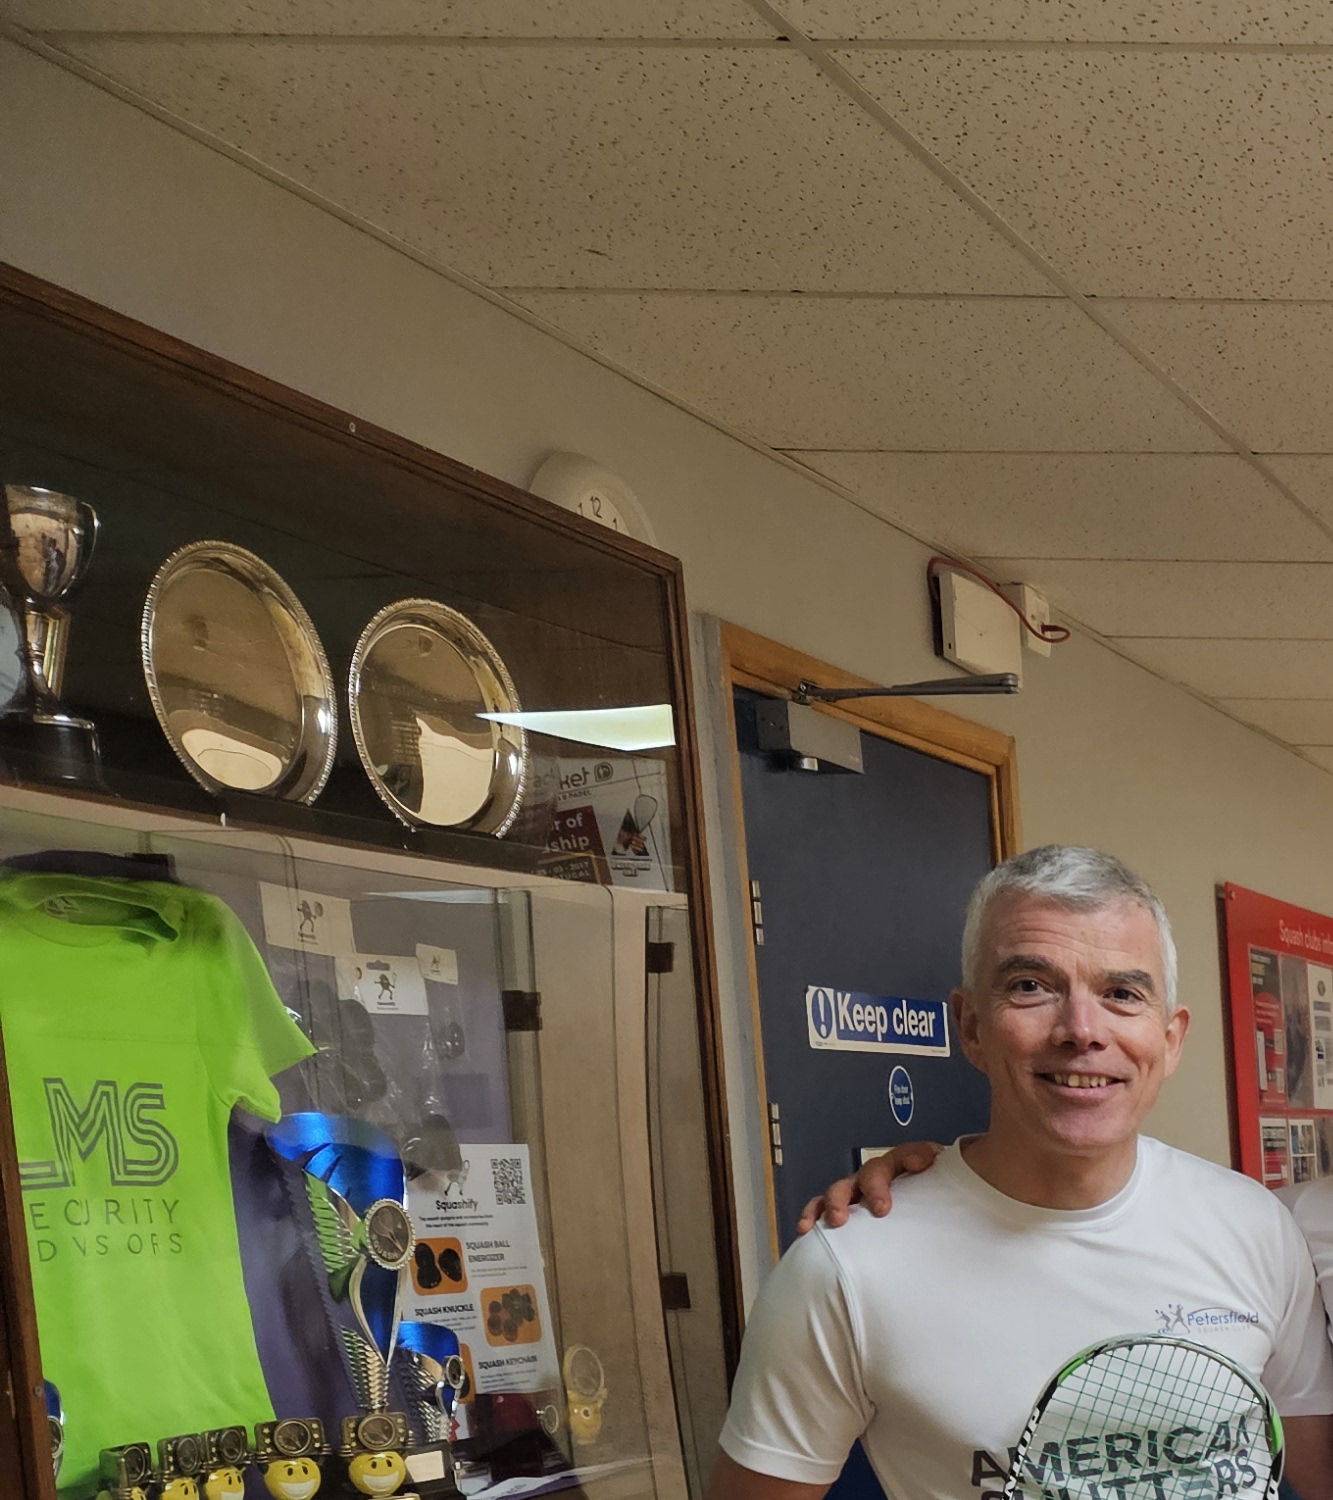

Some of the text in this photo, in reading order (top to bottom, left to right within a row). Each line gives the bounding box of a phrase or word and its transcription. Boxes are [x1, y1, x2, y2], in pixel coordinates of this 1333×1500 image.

[589, 496, 602, 519] 12
[1279, 919, 1303, 948] Squash
[1304, 926, 1321, 951] clubs
[836, 992, 936, 1042] Keep clear
[29, 1198, 180, 1231] ECURITY
[435, 1199, 478, 1213] Squashify
[466, 1239, 510, 1251] SQUASH BALL
[415, 1306, 443, 1318] SQUASH
[1187, 1311, 1260, 1327] Petersfield
[478, 1360, 505, 1370] SQUASH
[970, 1414, 1251, 1487] AMERICAN
